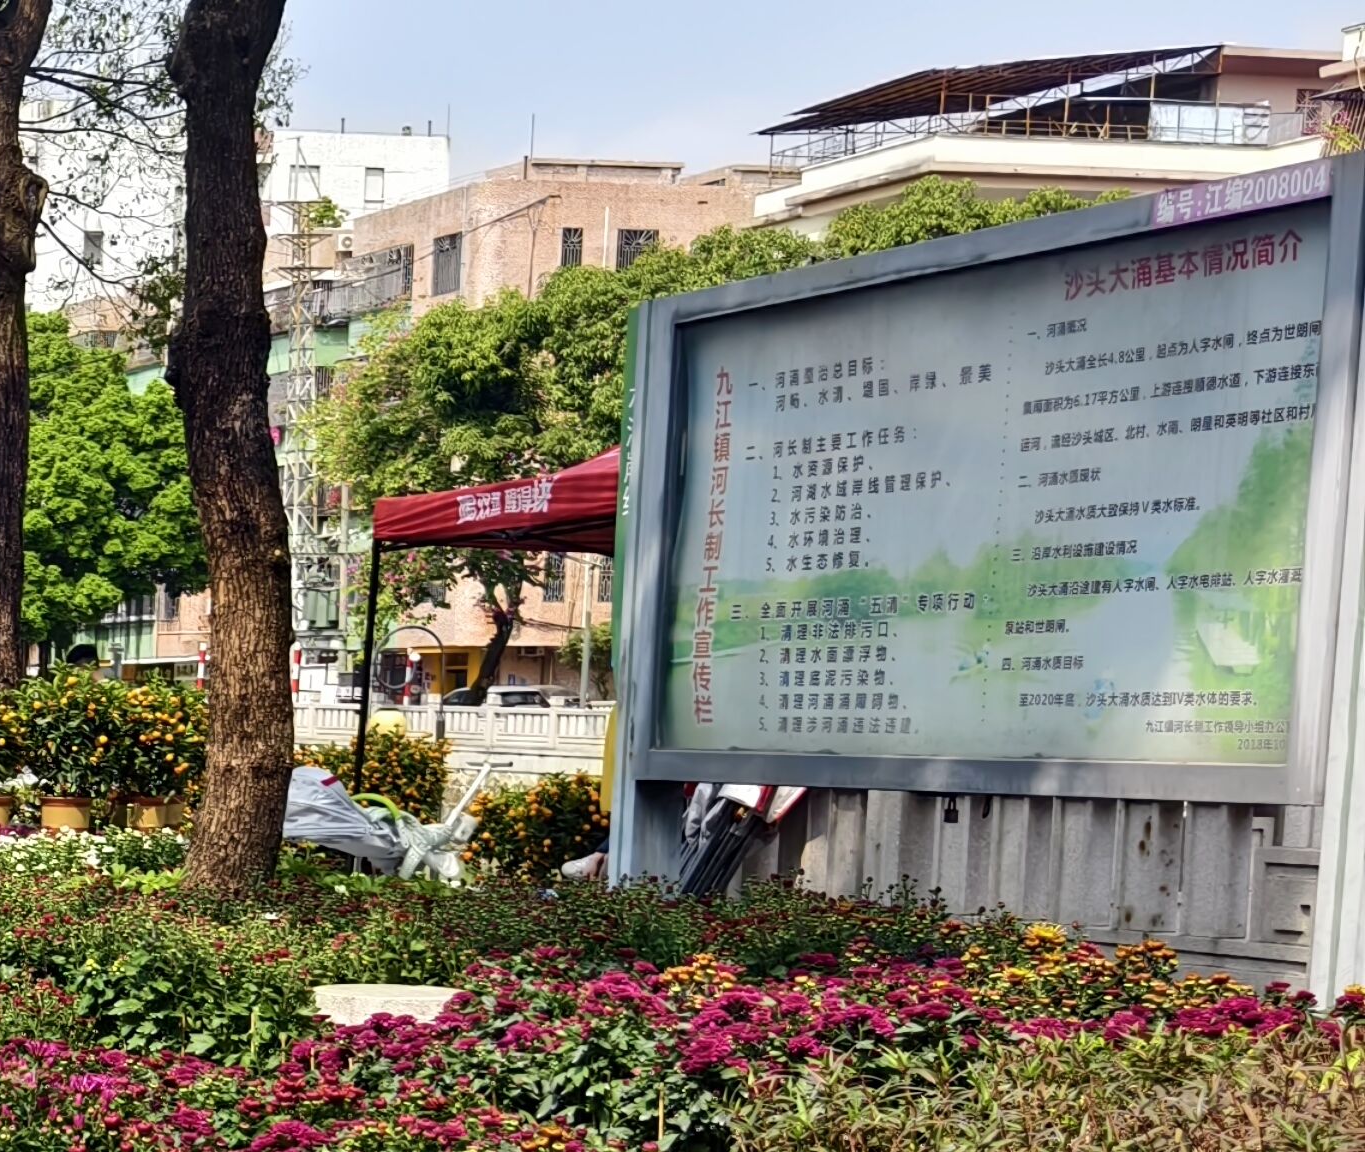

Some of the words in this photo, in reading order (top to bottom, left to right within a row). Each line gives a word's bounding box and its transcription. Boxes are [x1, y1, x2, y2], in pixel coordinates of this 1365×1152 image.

[1064, 229, 1303, 301] 沙头大涌基本情况简介
[693, 366, 733, 724] 九江镇河长制工作宣传栏
[1145, 720, 1289, 734] 九江镇河长制工作领导小组办公
